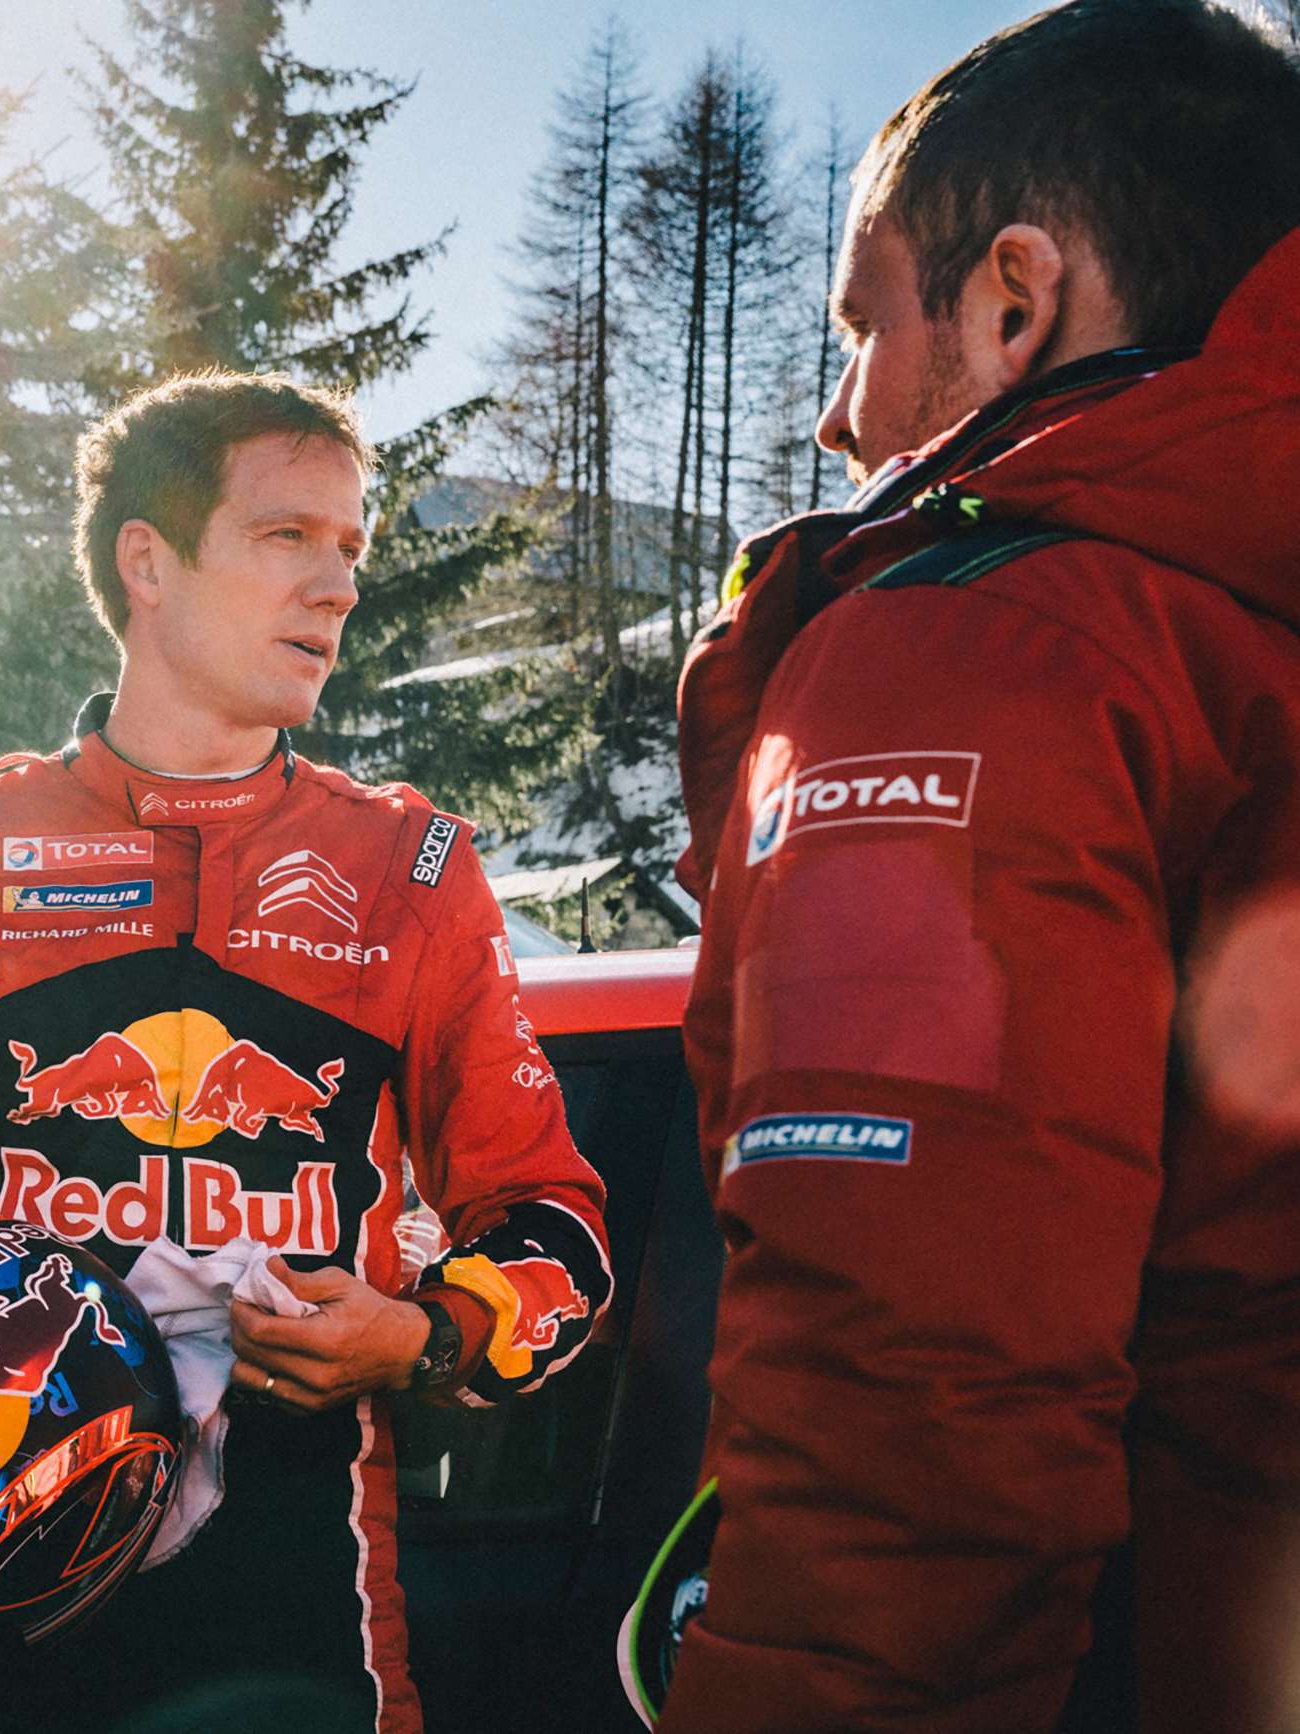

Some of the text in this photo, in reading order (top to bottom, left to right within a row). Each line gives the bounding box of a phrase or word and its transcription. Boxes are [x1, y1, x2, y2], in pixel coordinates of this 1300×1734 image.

[793, 774, 960, 817] TOTAL
[46, 841, 148, 861] TOTAL
[412, 817, 457, 886] sparco
[46, 889, 141, 905] MICHELIN
[1, 921, 155, 942] RICHARD MILLE
[741, 1124, 904, 1150] MICHELIN
[183, 1157, 340, 1256] Bull
